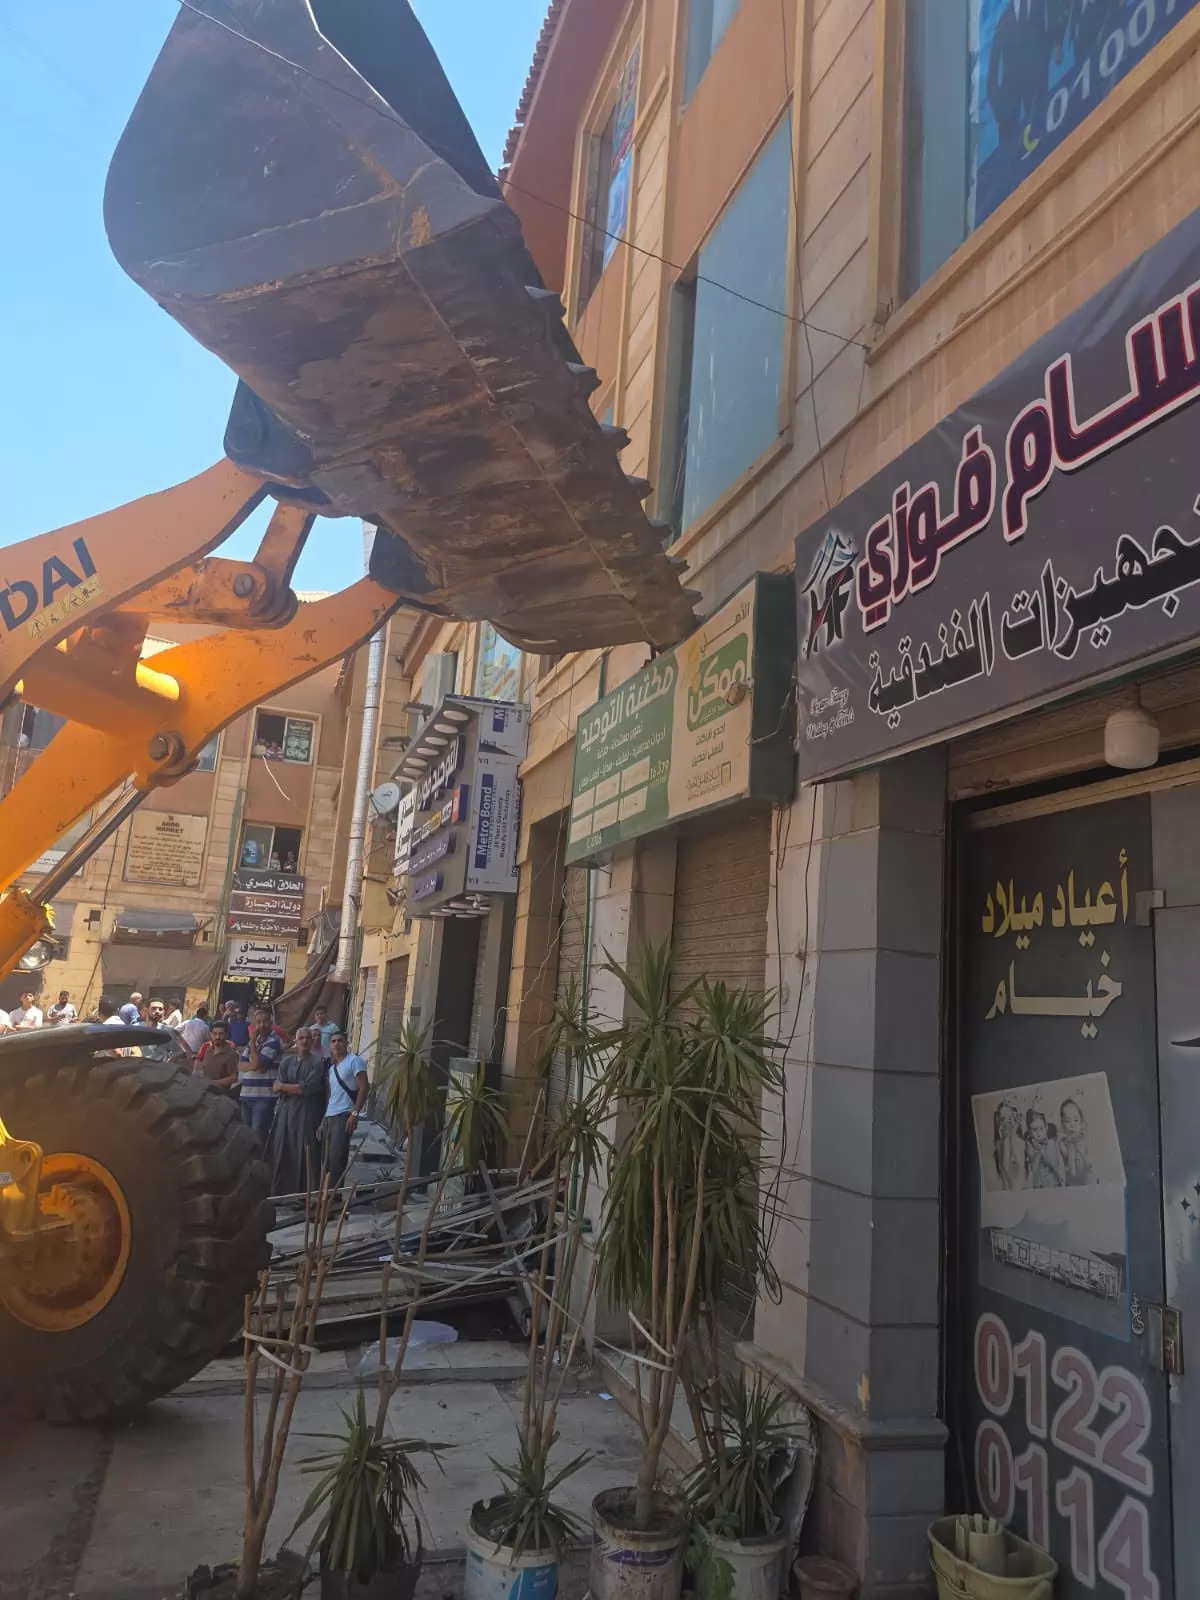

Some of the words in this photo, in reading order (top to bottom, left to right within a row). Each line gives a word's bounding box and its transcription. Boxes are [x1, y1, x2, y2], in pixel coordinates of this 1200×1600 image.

[1046, 0, 1176, 133] 0100
[855, 424, 996, 632] فوزي
[1002, 493, 1200, 660] جهيزات
[0, 536, 97, 632] DAI
[625, 666, 674, 720] مكتبة
[868, 591, 994, 728] الفندقية
[580, 690, 625, 753] التوحيد
[477, 819, 490, 856] Metro
[479, 786, 493, 818] Bond
[982, 877, 1044, 950] ميلاد
[1051, 847, 1129, 948] أعياد
[984, 950, 1123, 1040] خيام
[974, 1312, 1155, 1497] 0122
[975, 1418, 1161, 1600] 0114
